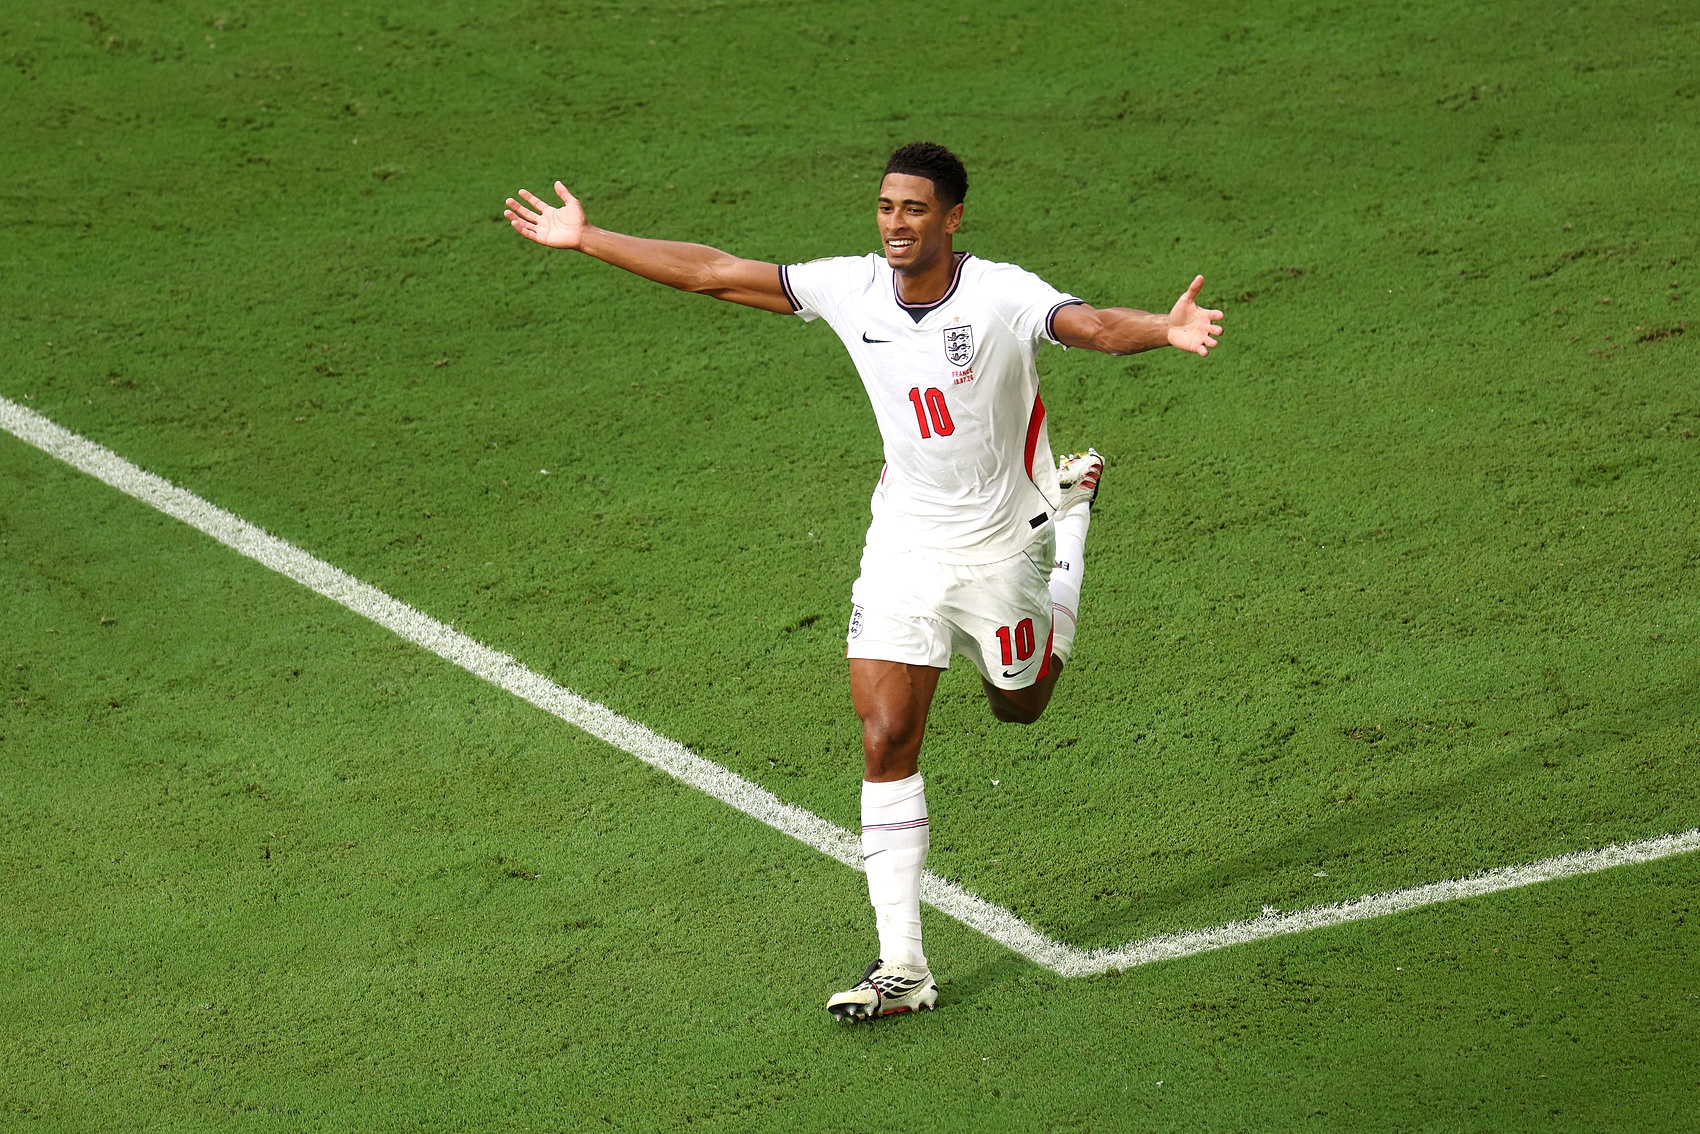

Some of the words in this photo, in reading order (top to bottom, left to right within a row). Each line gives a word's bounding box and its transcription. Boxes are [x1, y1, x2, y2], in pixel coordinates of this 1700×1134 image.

[952, 367, 974, 377] FRANCE
[908, 387, 955, 439] 10
[995, 617, 1035, 665] 10
